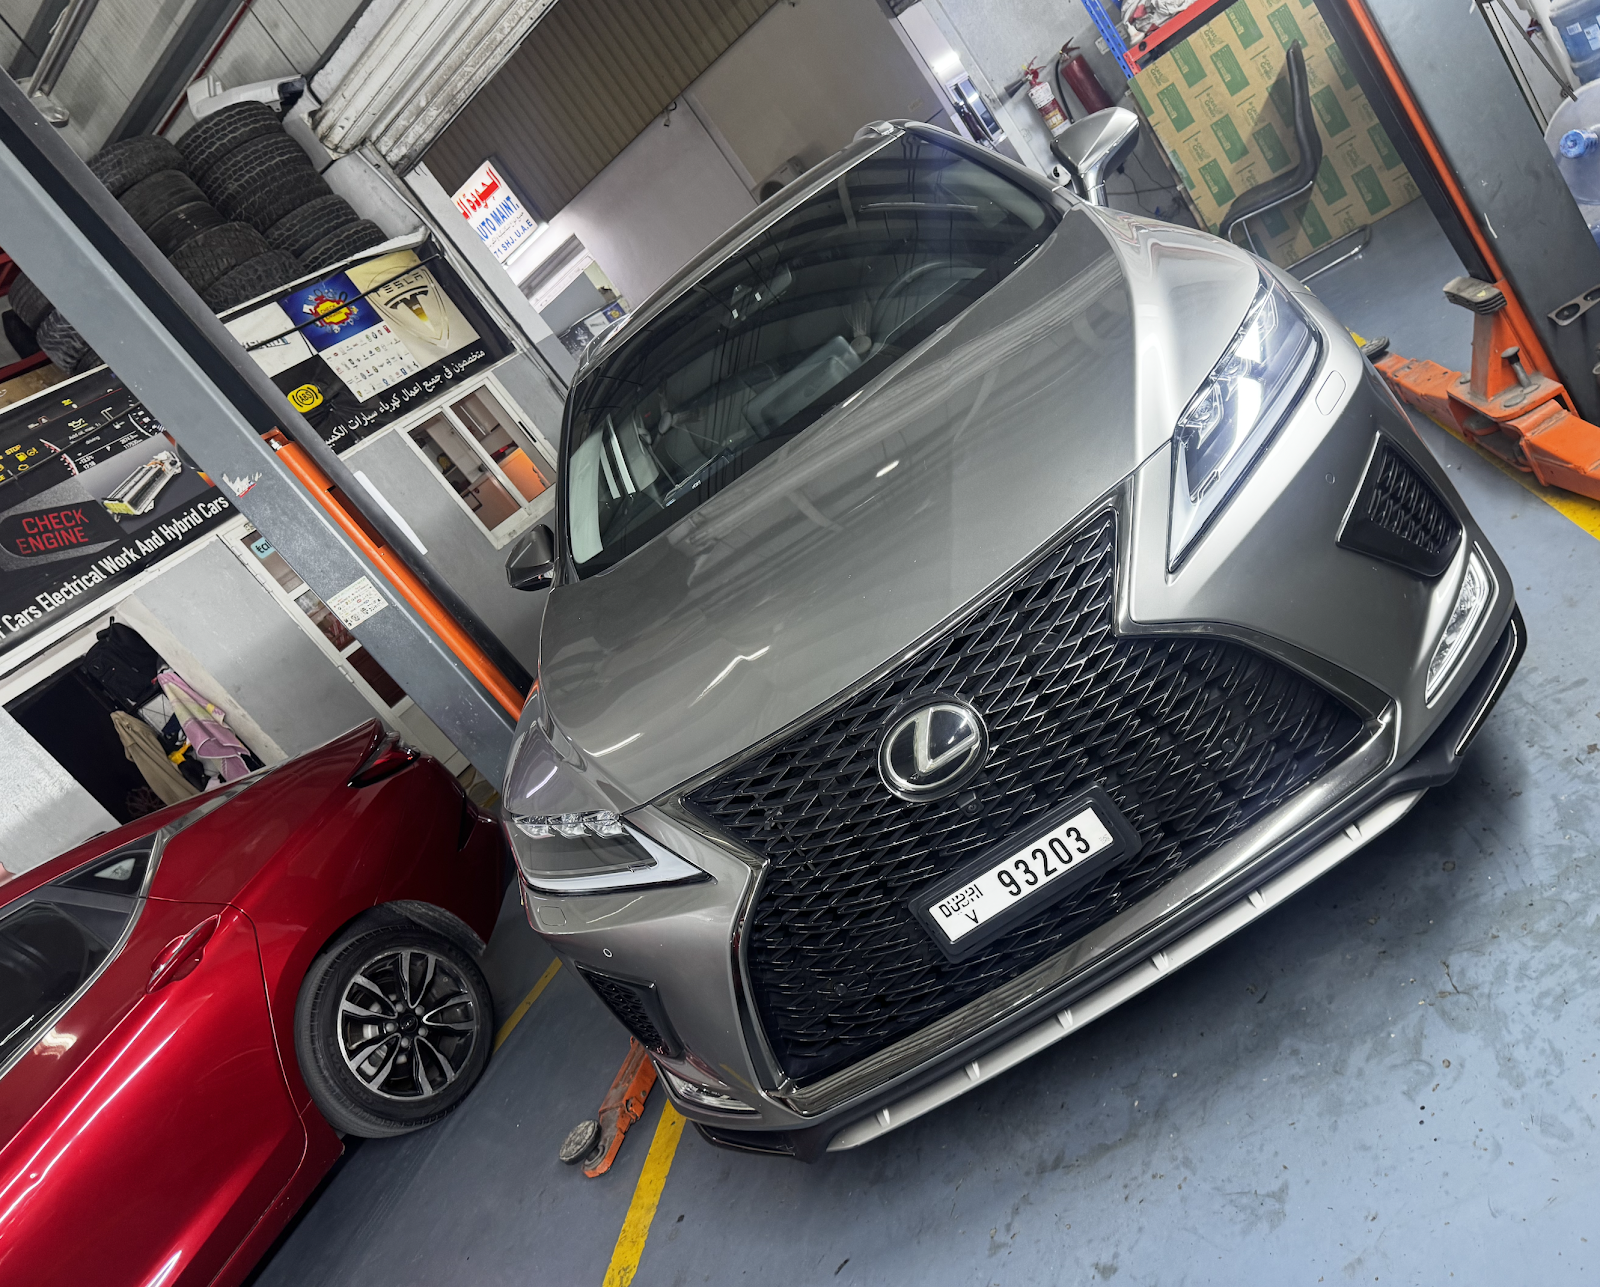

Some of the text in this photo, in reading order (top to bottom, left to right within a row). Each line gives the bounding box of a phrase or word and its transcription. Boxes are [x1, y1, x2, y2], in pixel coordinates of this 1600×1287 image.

[1259, 61, 1274, 82] Green
[1204, 100, 1217, 119] Green
[463, 169, 500, 211] الجودة
[490, 196, 520, 225] MAINT.
[501, 237, 515, 251] SHJ.
[515, 220, 533, 238] U.A.E
[451, 350, 485, 373] متخصصون
[401, 382, 422, 401] اعمال
[422, 375, 443, 392] جميع
[299, 391, 312, 401] ABS
[379, 393, 401, 413] كهرباء
[348, 411, 378, 430] سيارات
[5, 444, 22, 456] STOP
[22, 509, 89, 534] CHECK
[16, 527, 89, 554] ENGINE
[1, 606, 43, 635] Cars
[35, 565, 107, 612] Electrical
[98, 547, 141, 574] Work
[135, 530, 165, 556] And
[158, 508, 203, 541] Hybrid
[197, 497, 229, 518] Cars
[997, 827, 1090, 896] 93203
[965, 909, 979, 924] V
